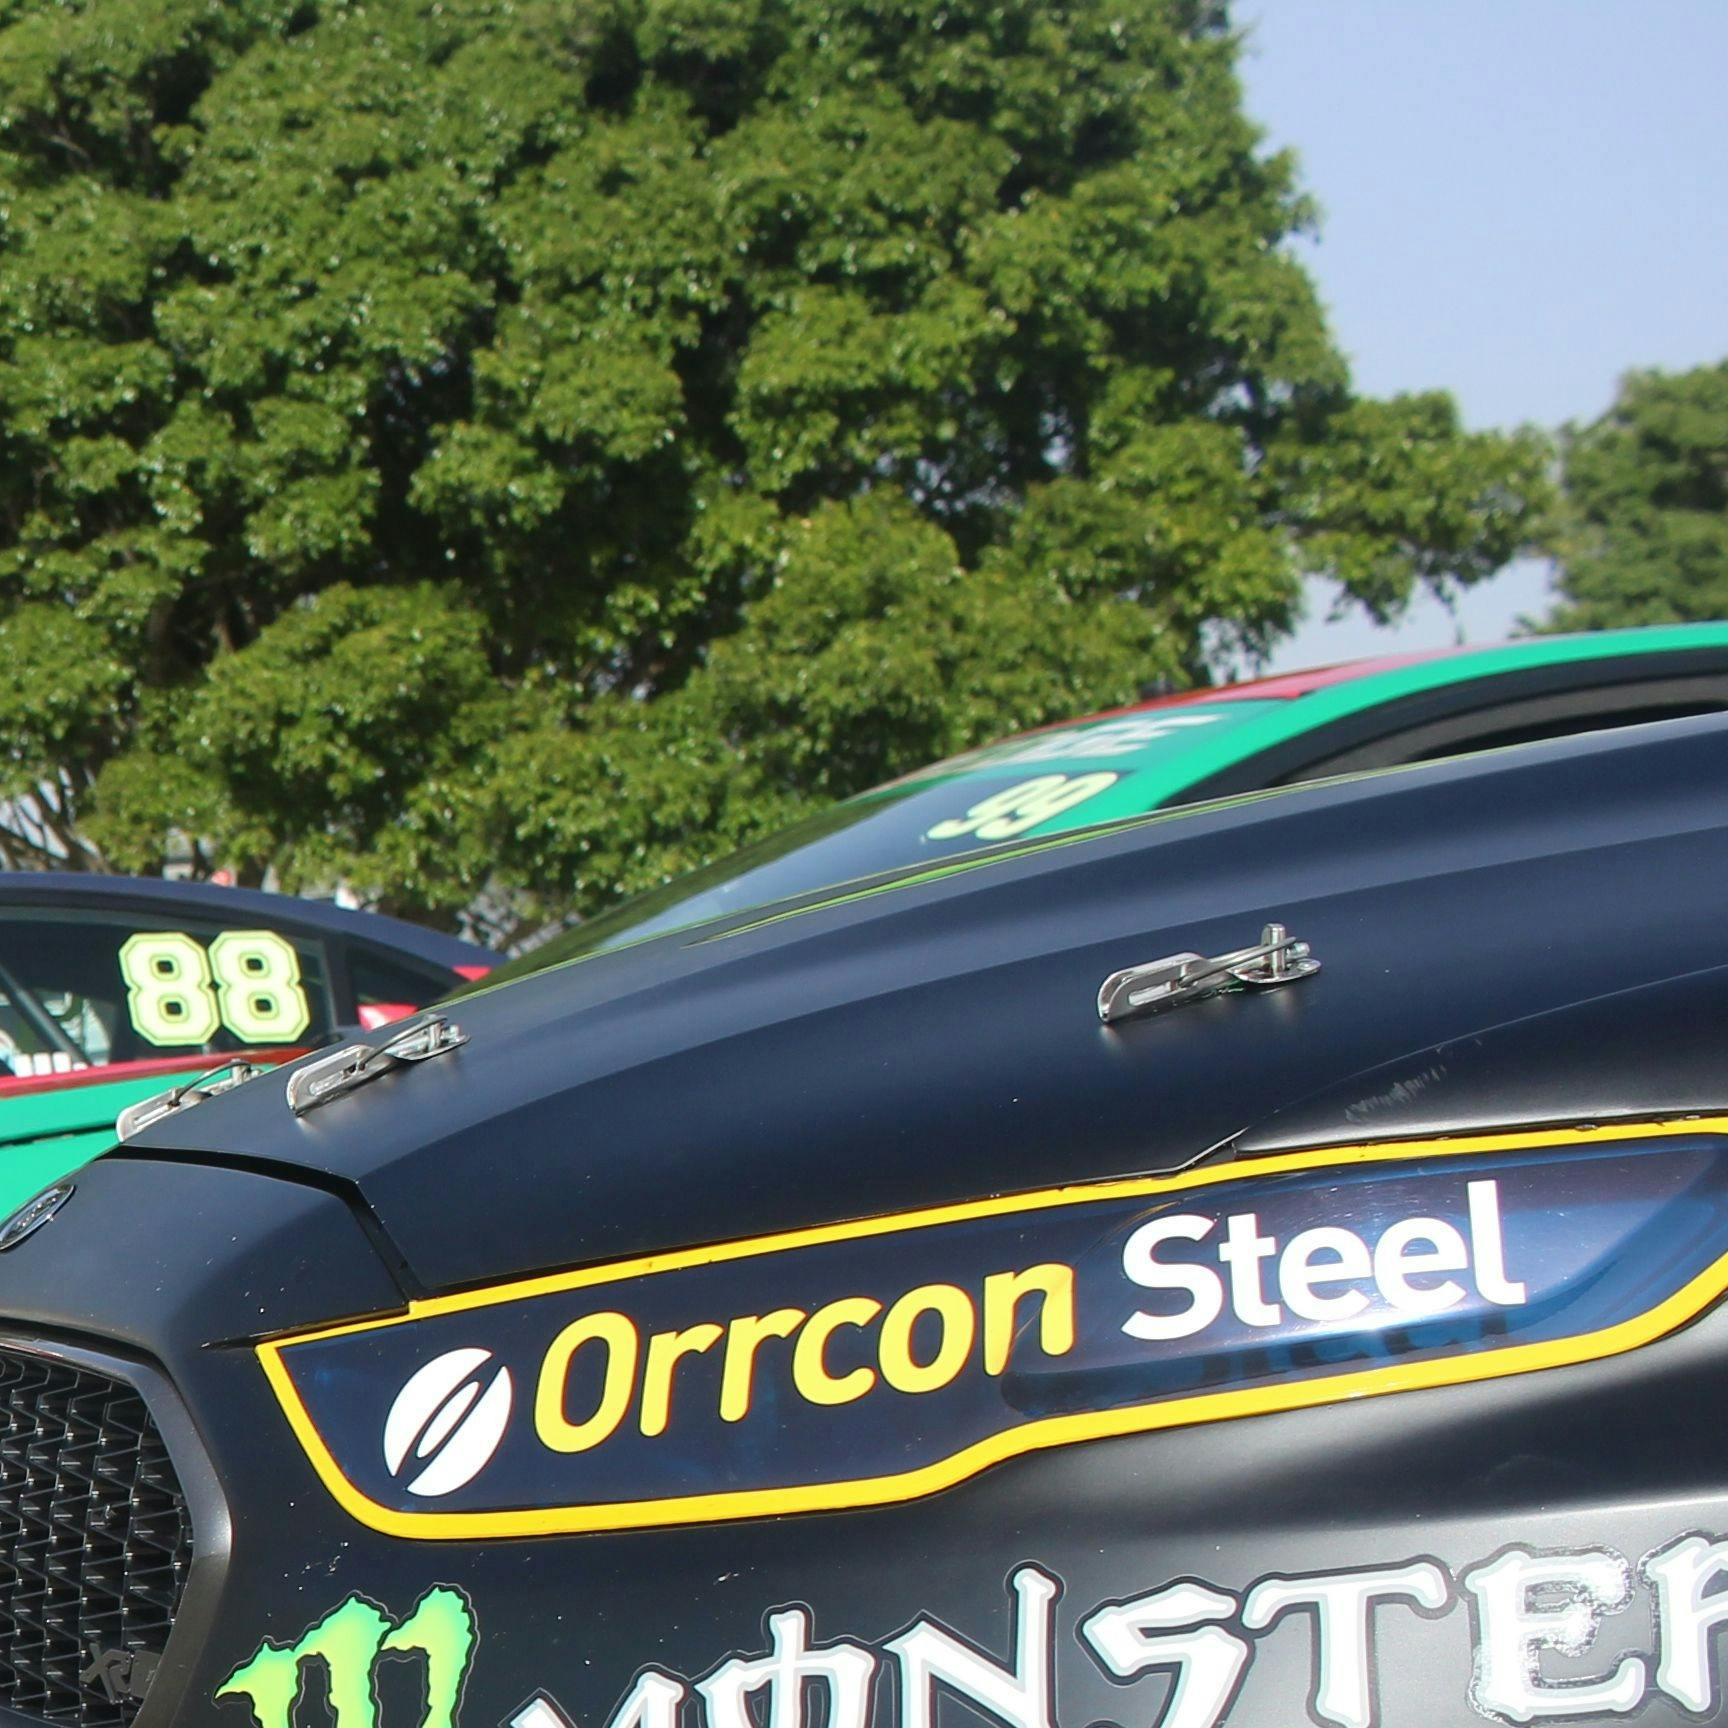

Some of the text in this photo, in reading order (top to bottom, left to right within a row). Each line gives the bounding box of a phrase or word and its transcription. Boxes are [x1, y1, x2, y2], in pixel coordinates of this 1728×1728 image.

[119, 930, 310, 1046] 88
[531, 1180, 1527, 1454] Orrcon Steel
